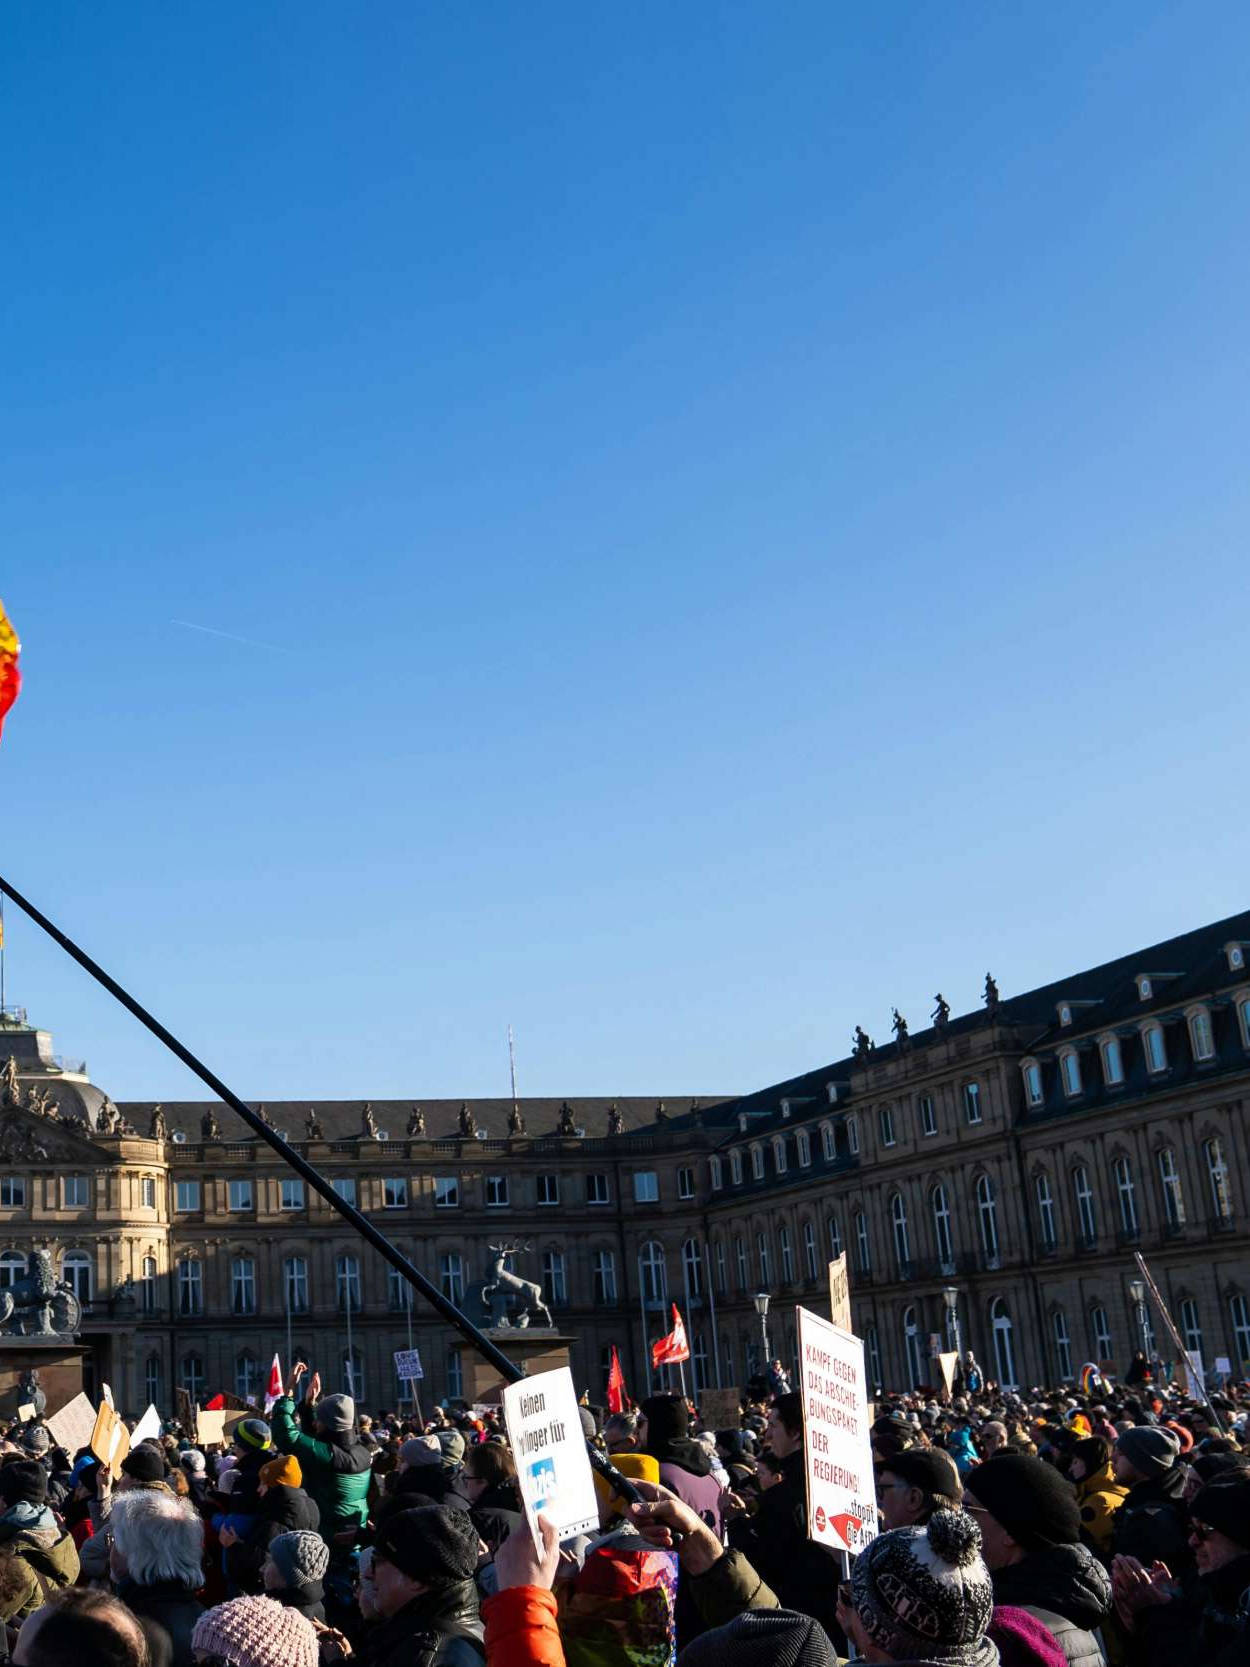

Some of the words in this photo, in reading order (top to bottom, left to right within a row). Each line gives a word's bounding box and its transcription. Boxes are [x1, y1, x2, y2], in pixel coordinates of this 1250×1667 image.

[806, 1344, 831, 1372] KAMPF
[833, 1358, 856, 1385] GEGEN
[519, 1391, 546, 1418] Keinen
[808, 1371, 823, 1394] DAS
[825, 1380, 860, 1411] ABSCHIE-
[549, 1418, 565, 1444] für
[810, 1398, 858, 1436] BUNGSPAKET
[812, 1430, 829, 1454] DER
[813, 1458, 860, 1494] REGIERUNG!
[847, 1521, 857, 1545] die
